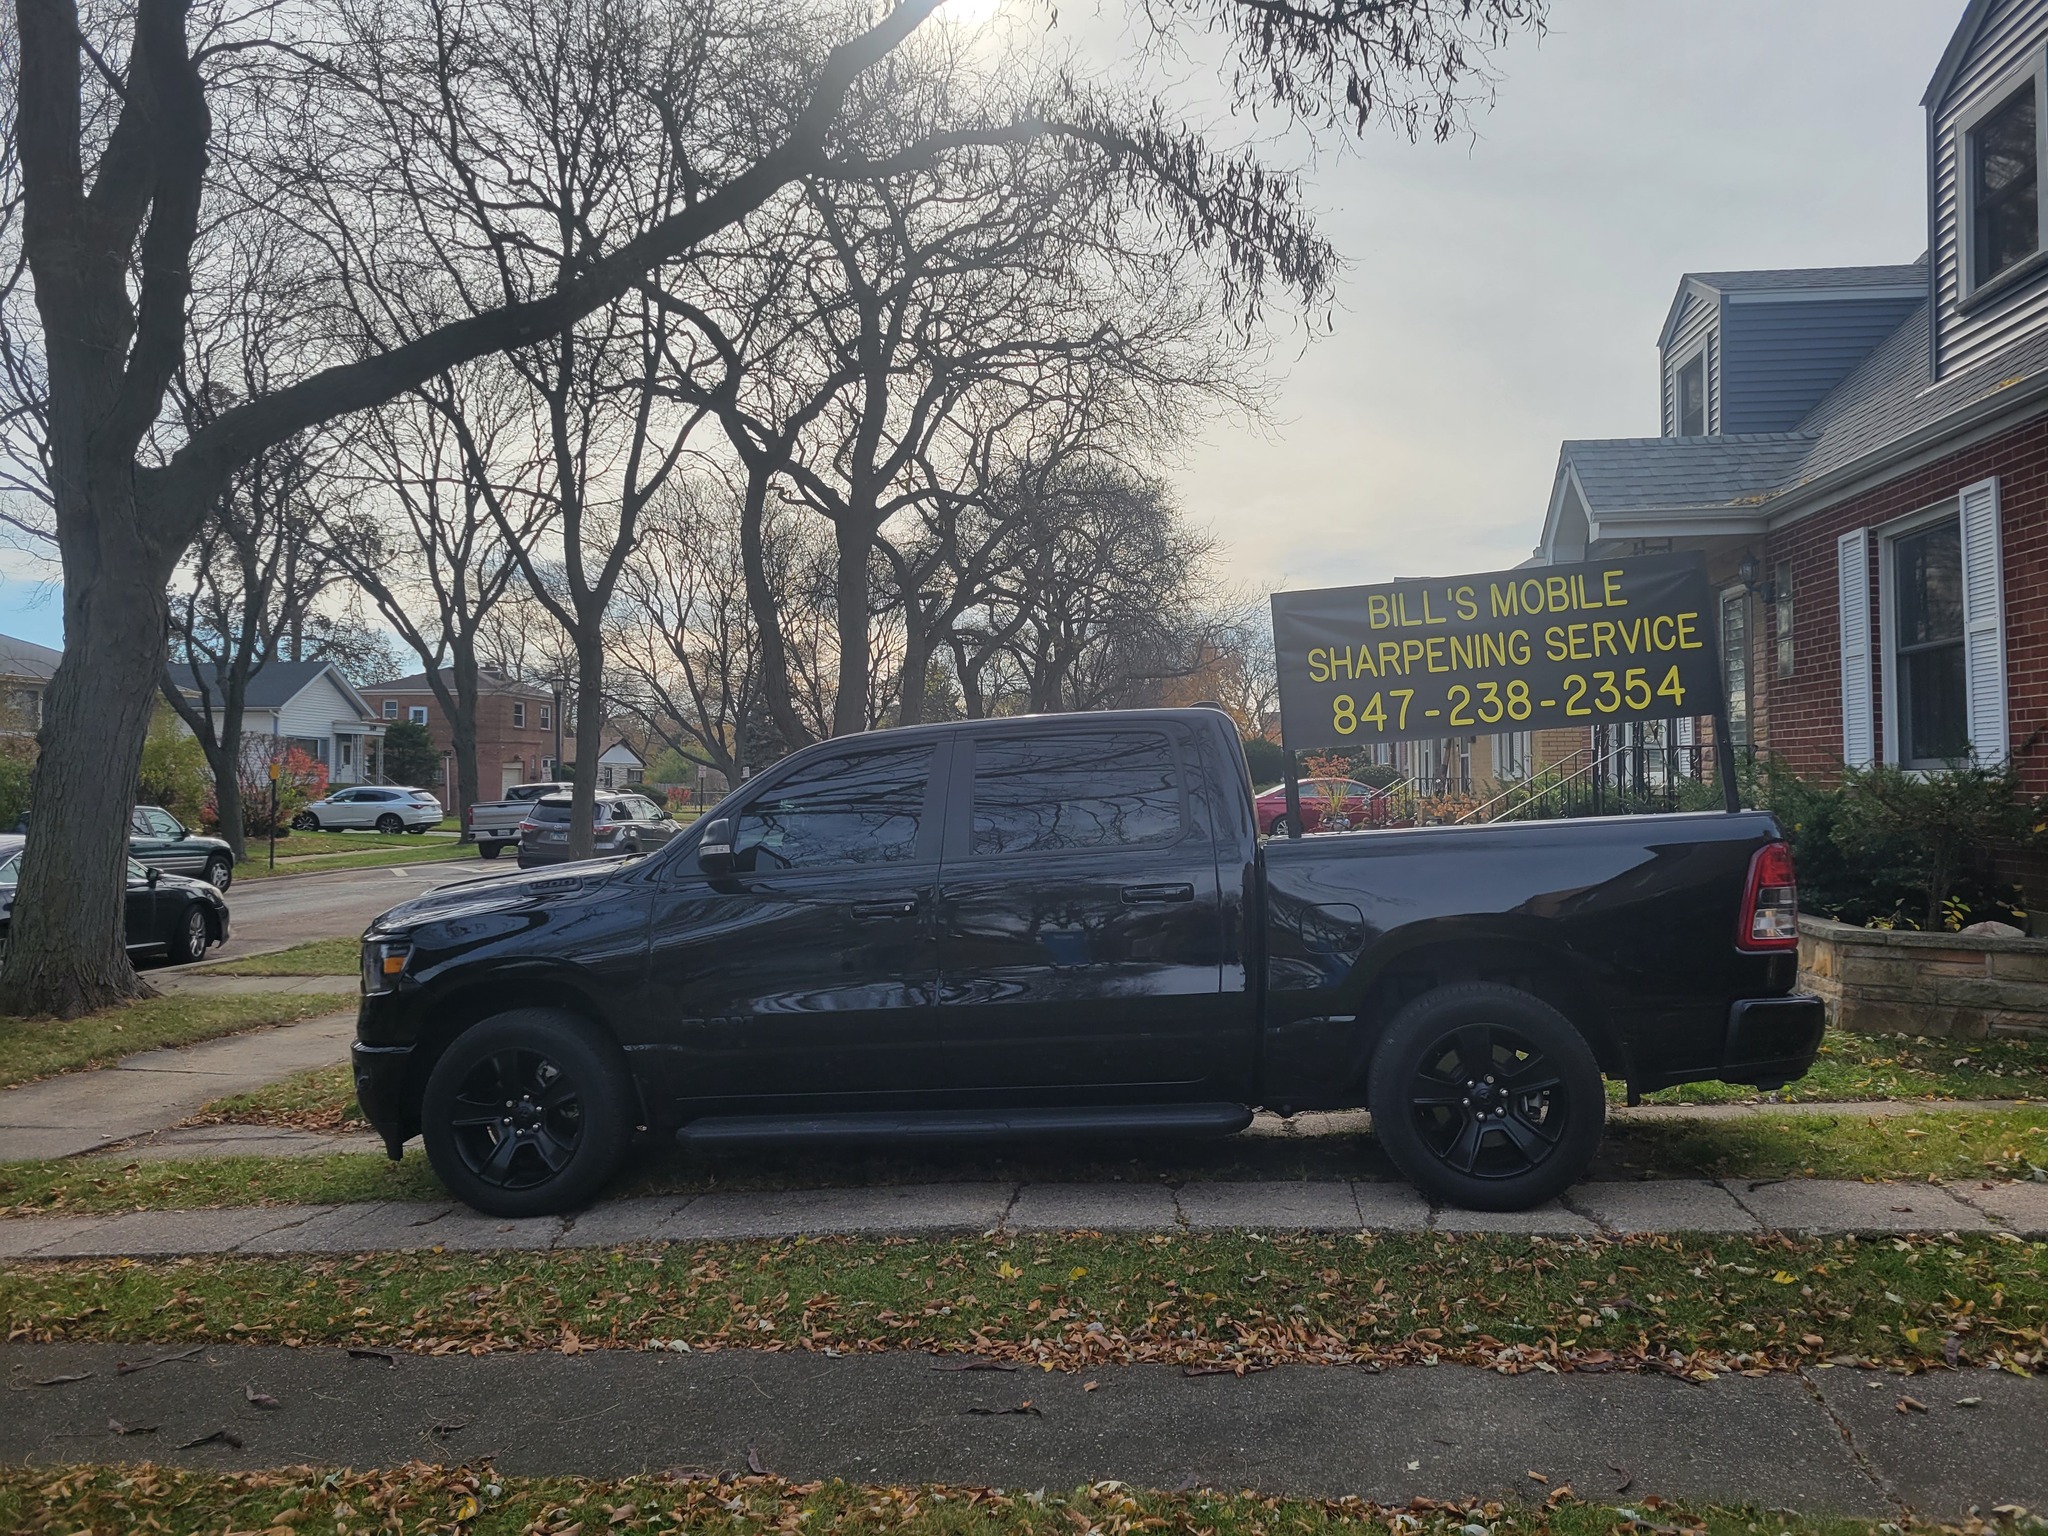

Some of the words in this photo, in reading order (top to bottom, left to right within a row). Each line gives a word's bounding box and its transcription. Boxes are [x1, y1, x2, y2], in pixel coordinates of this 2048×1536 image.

[1368, 586, 1478, 630] BILL'S
[1490, 569, 1629, 618] MOBILE
[1307, 629, 1532, 683] SHARPENING
[1545, 612, 1703, 662] SERVICE
[1332, 664, 1687, 736] 847-238-2354
[529, 878, 575, 890] 1500
